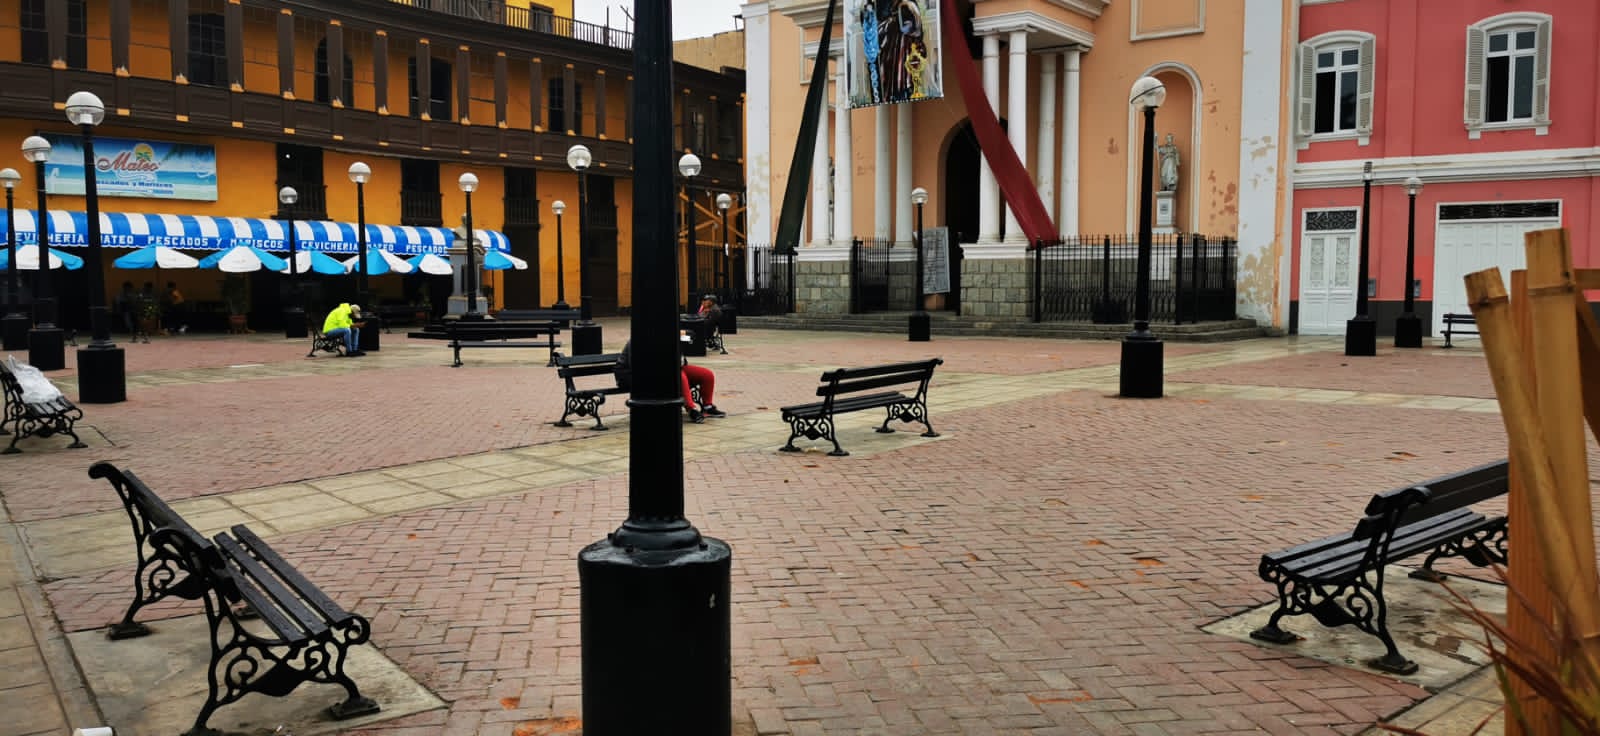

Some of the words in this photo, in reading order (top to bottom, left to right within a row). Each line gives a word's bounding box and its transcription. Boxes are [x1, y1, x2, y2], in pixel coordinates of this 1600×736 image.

[97, 151, 160, 172] Mateo
[6, 232, 85, 244] EVIHERIA
[147, 235, 209, 247] PESCADOS
[216, 237, 222, 247] Y
